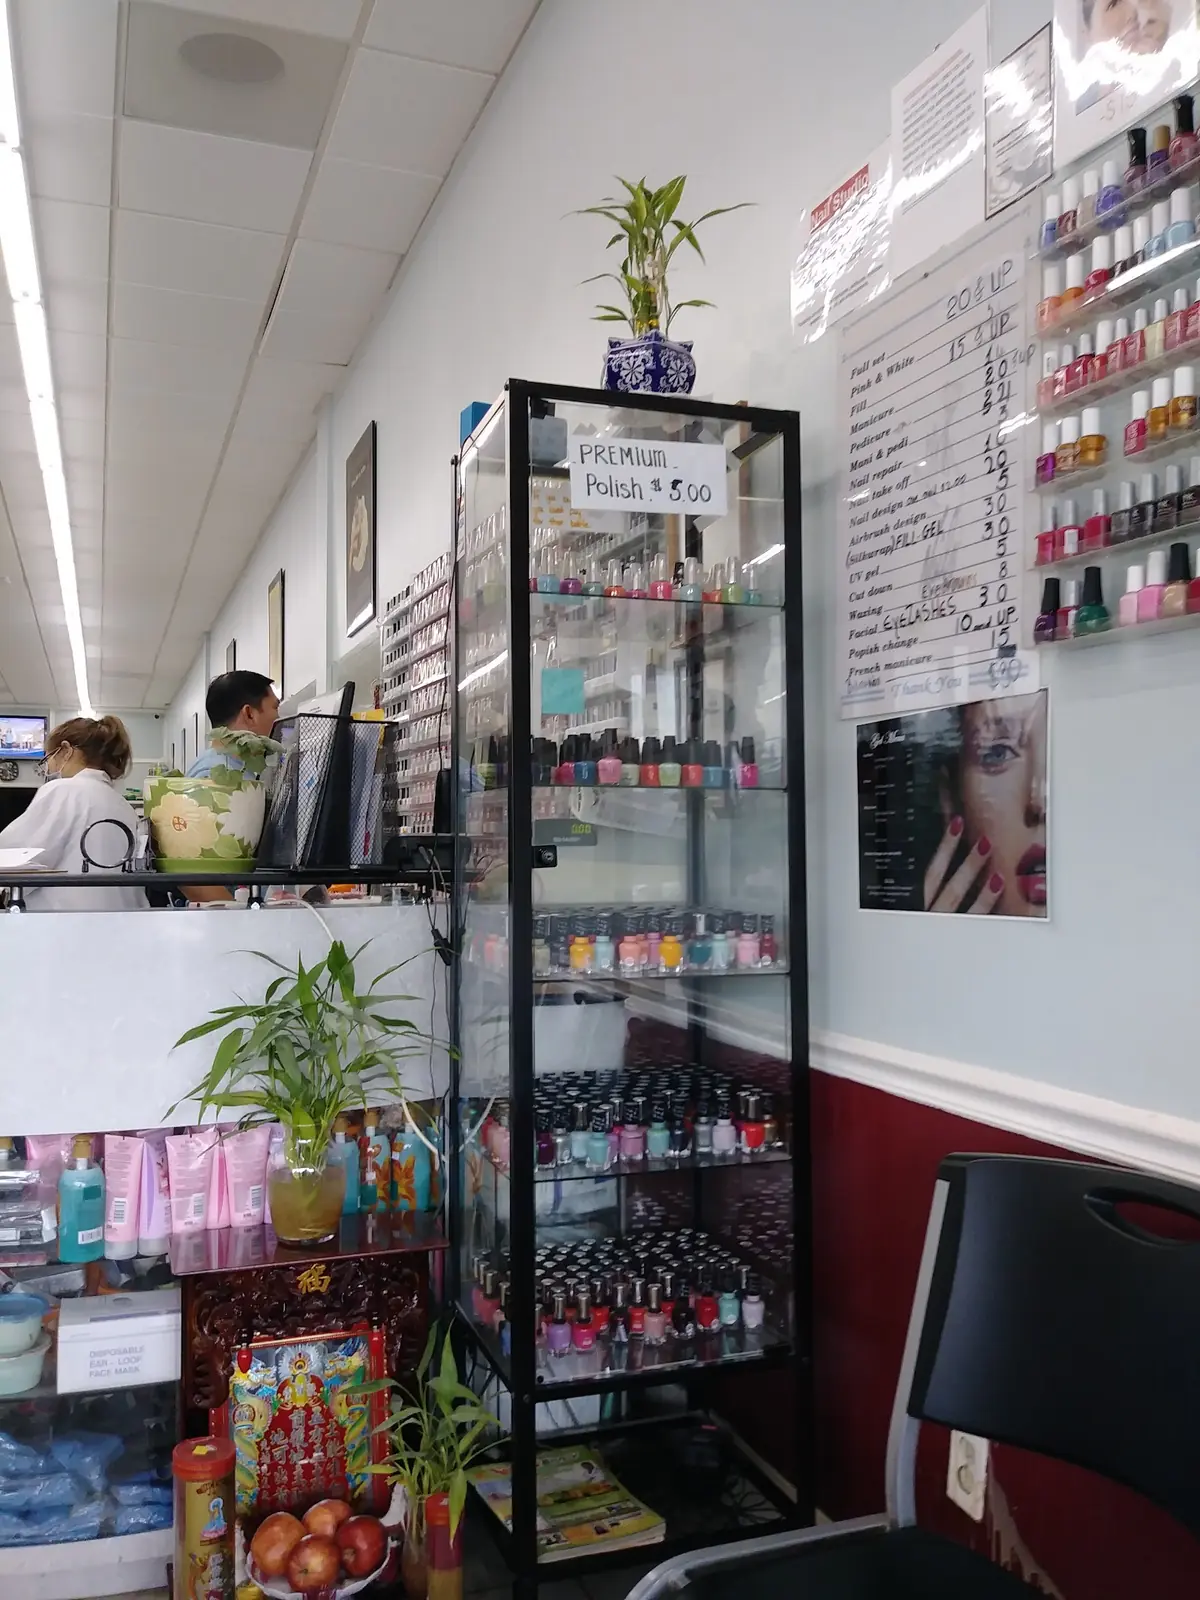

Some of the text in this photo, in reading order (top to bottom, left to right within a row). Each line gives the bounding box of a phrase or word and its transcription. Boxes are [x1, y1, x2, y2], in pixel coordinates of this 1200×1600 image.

[850, 360, 869, 380] Full
[872, 352, 885, 366] set
[947, 287, 971, 320] 20
[991, 259, 1013, 293] UP
[850, 399, 867, 417] Fill
[949, 336, 966, 362] 15
[991, 312, 1010, 341] UP
[850, 356, 915, 399] Pink & White
[849, 407, 894, 435] Manicure
[849, 428, 891, 454] Pedicure
[849, 453, 873, 473] Mani
[876, 448, 883, 460] &
[886, 436, 908, 458] pedi
[849, 473, 870, 491] Nail
[872, 461, 903, 480] repair
[849, 512, 869, 528] Nail
[872, 500, 903, 519] design
[984, 450, 1007, 474] 20
[872, 485, 892, 501] take
[896, 474, 911, 491] off
[849, 467, 1009, 547] Airbrush design 5
[983, 493, 1006, 516] 30
[849, 536, 1008, 602] Cut down 5
[849, 571, 863, 584] UV
[865, 565, 879, 581] gel
[849, 605, 883, 621] Waxing
[999, 561, 1008, 578] 8
[849, 624, 878, 641] Facial
[980, 583, 1007, 608] 30
[882, 637, 918, 652] change
[956, 613, 972, 634] 10
[997, 606, 1016, 626] UP
[847, 626, 1010, 680] French manicure 15
[89, 1345, 145, 1358] DISPOSABLE
[89, 1359, 108, 1369] EAR
[118, 1355, 142, 1365] LOOP
[89, 1366, 140, 1378] FACE MASK
